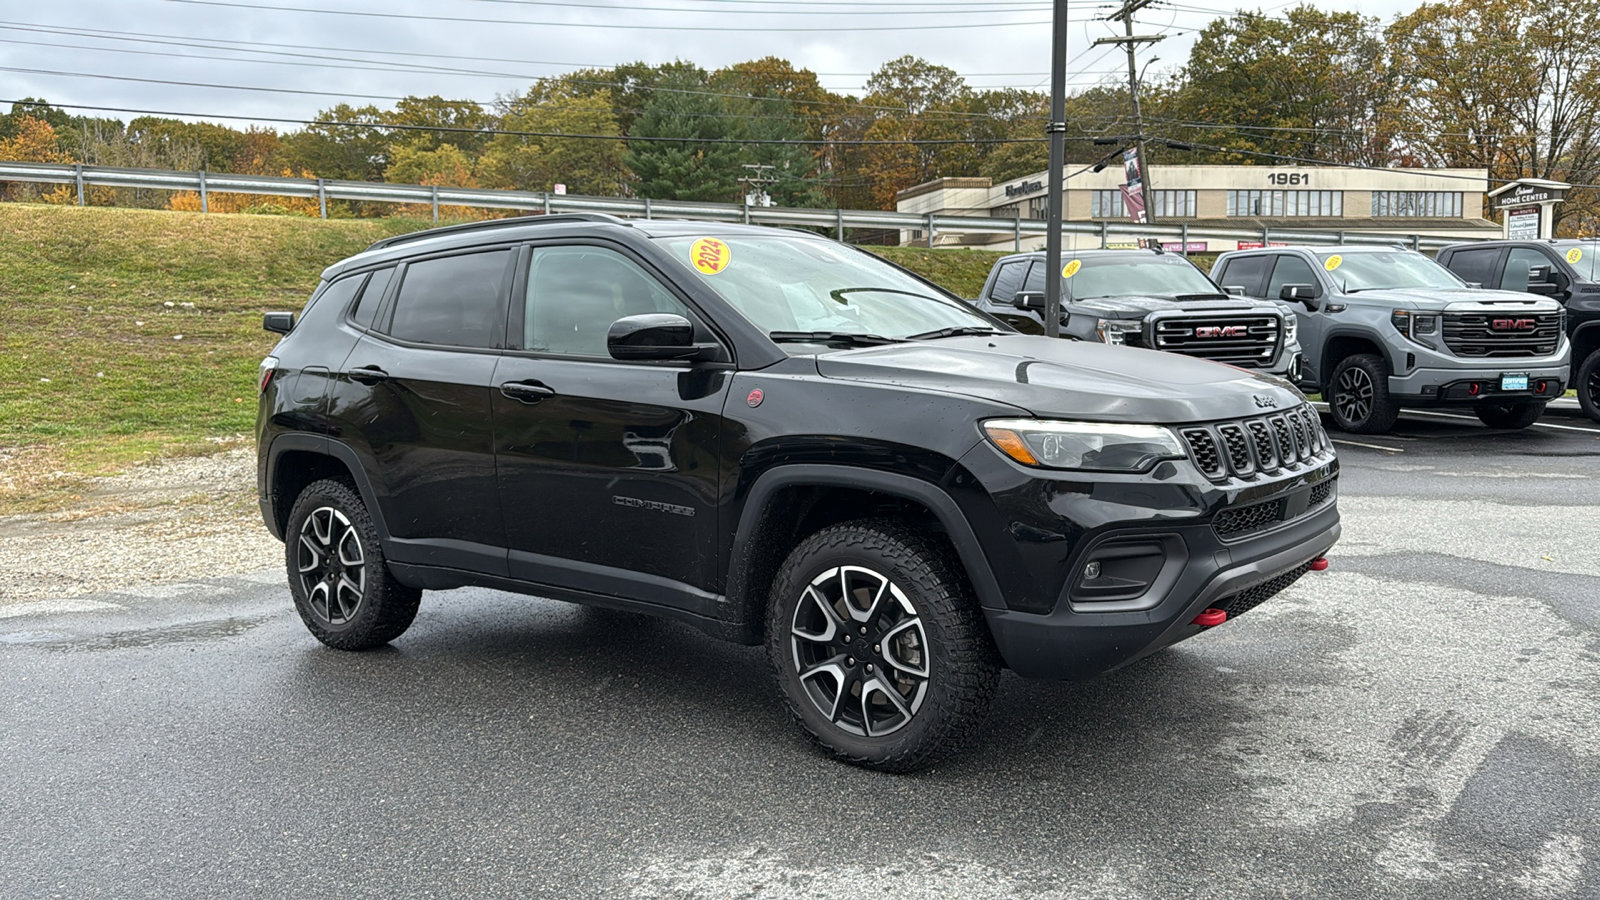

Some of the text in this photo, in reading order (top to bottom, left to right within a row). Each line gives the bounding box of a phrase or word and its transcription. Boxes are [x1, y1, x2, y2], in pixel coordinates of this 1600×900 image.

[1268, 173, 1309, 185] 1961
[1502, 193, 1548, 205] HOME CENTER
[697, 239, 722, 271] 2024
[1493, 319, 1535, 329] GMC
[1196, 325, 1247, 338] GMC
[1253, 394, 1278, 409] Jeep
[612, 495, 695, 517] COMPASS
